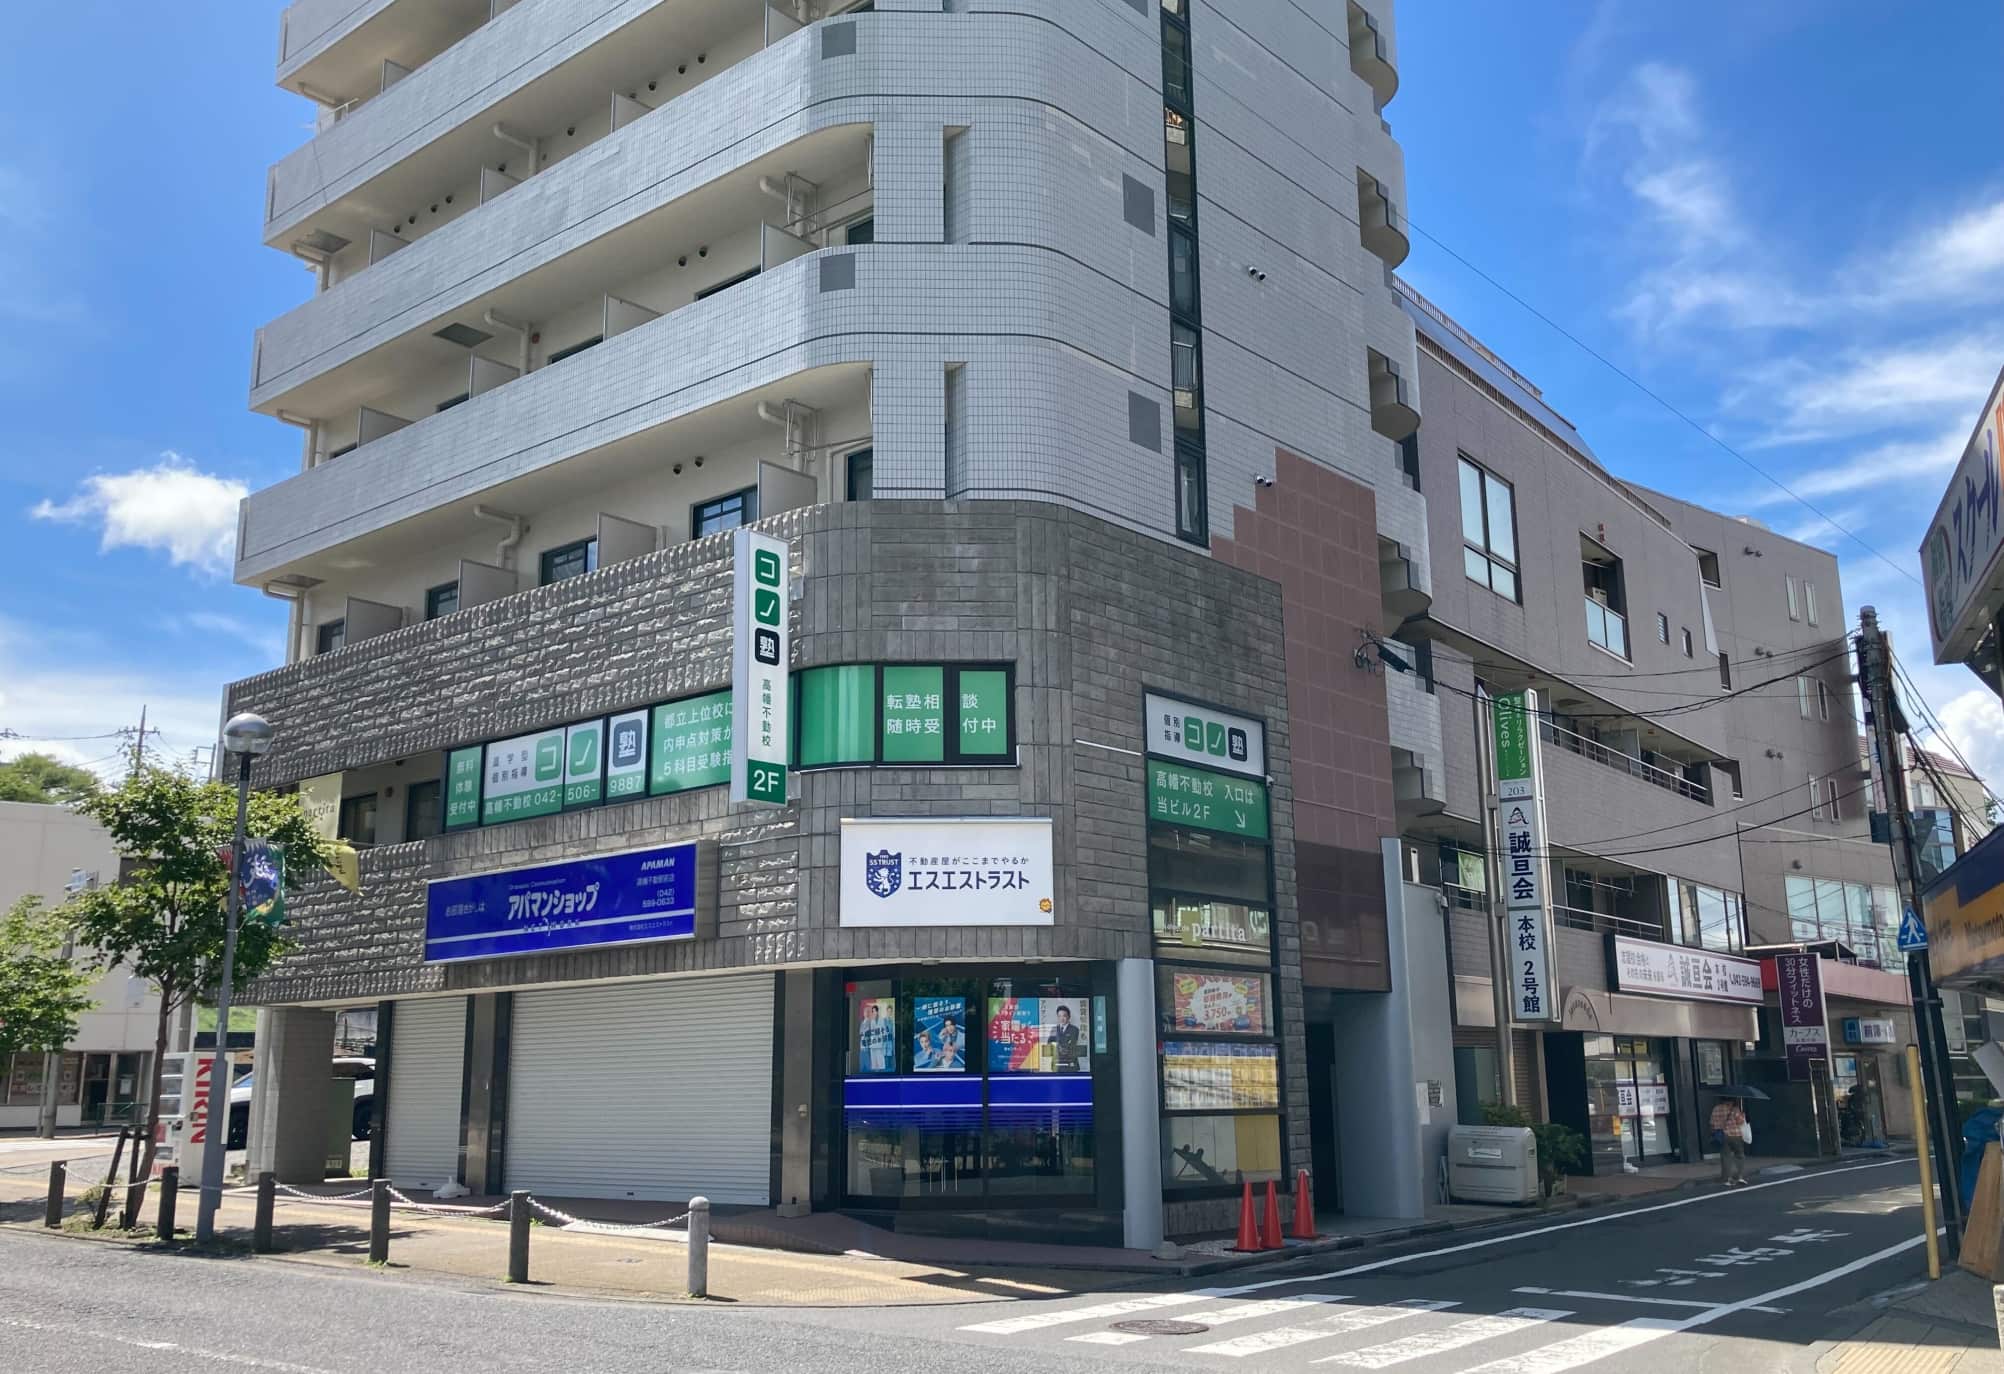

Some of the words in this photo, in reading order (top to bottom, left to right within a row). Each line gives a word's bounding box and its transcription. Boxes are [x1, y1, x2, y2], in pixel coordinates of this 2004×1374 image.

[757, 553, 779, 663] コノ塾
[753, 769, 780, 793] 2F
[1508, 786, 1526, 797] 203
[641, 857, 675, 871] APAMAN
[908, 856, 1030, 866] 不動産屋がここまでやるか
[907, 870, 1031, 891] エスエストラスト
[508, 882, 601, 921] アパマンショップ
[1517, 915, 1537, 952] 本校
[1521, 960, 1541, 1014] 2号館
[1785, 958, 1802, 1024] 30分フィットネス
[1798, 958, 1814, 1009] 女性だけの
